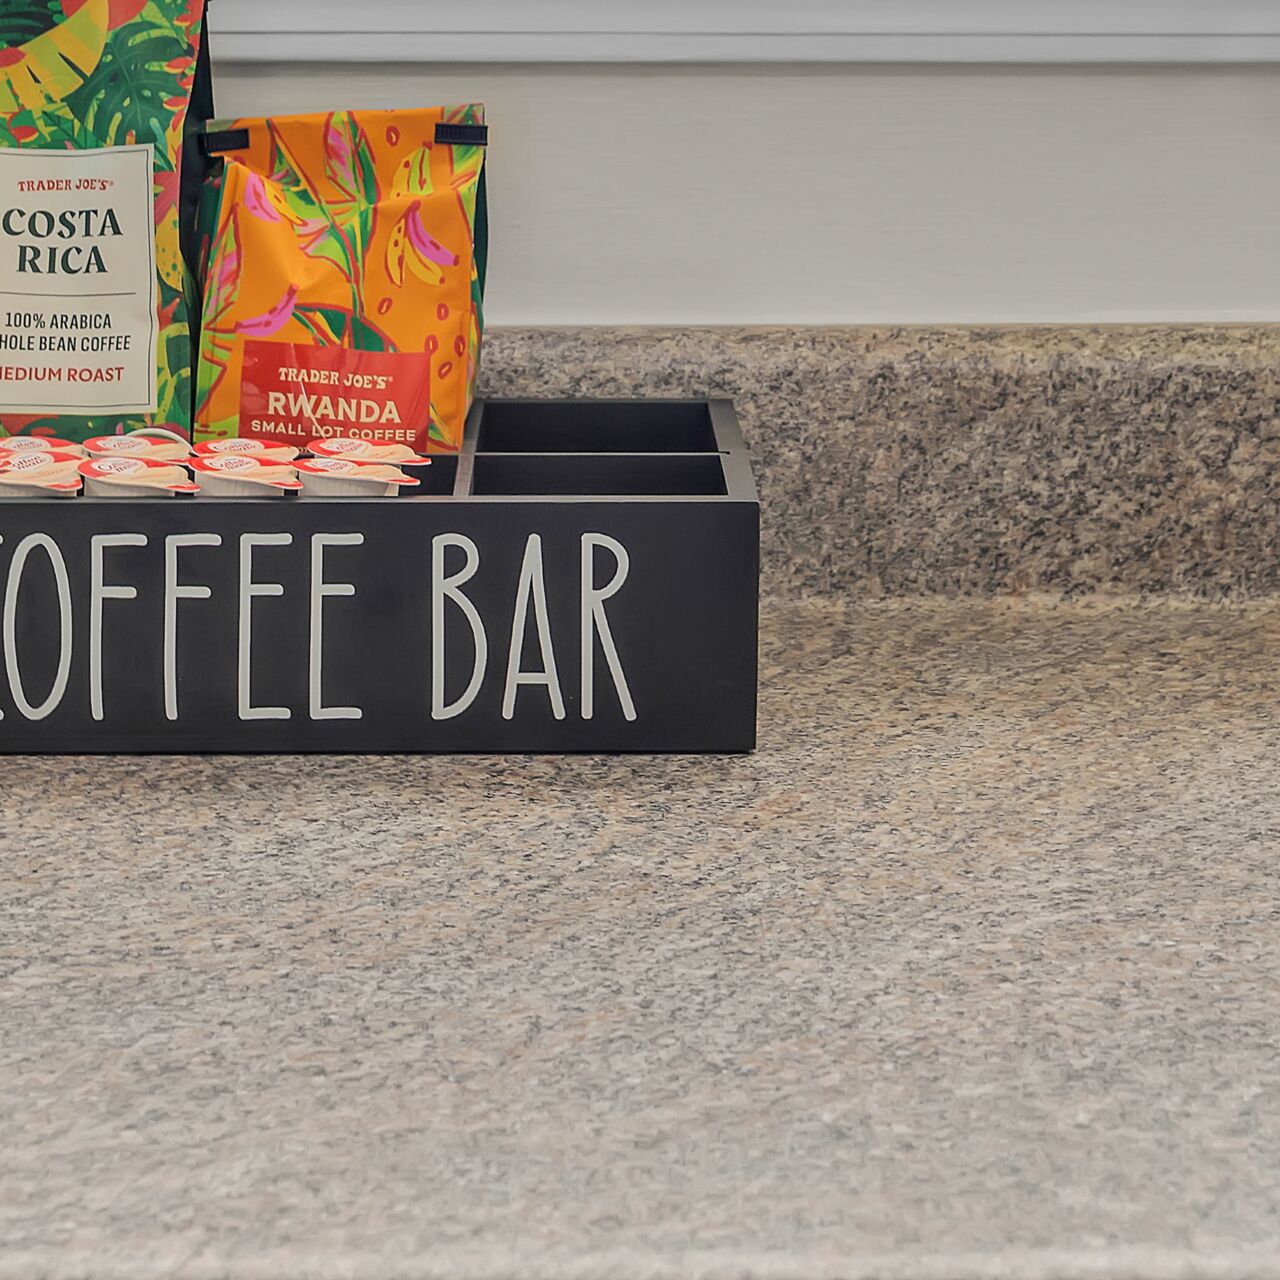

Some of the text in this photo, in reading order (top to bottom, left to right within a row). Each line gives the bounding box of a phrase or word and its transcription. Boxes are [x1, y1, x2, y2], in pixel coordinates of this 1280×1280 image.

[18, 178, 108, 192] TRADER JOE'S
[2, 208, 124, 239] COSTA
[16, 244, 109, 275] RICA
[5, 312, 112, 329] 100% ARABICA
[39, 336, 77, 351] BEAN
[81, 335, 132, 352] COFFEE
[67, 366, 125, 382] ROAST
[278, 367, 388, 389] TRADER JOE'S
[267, 391, 401, 424] RWANDA
[251, 419, 416, 441] SMALL LOT COFFEE
[431, 532, 637, 721] BAR
